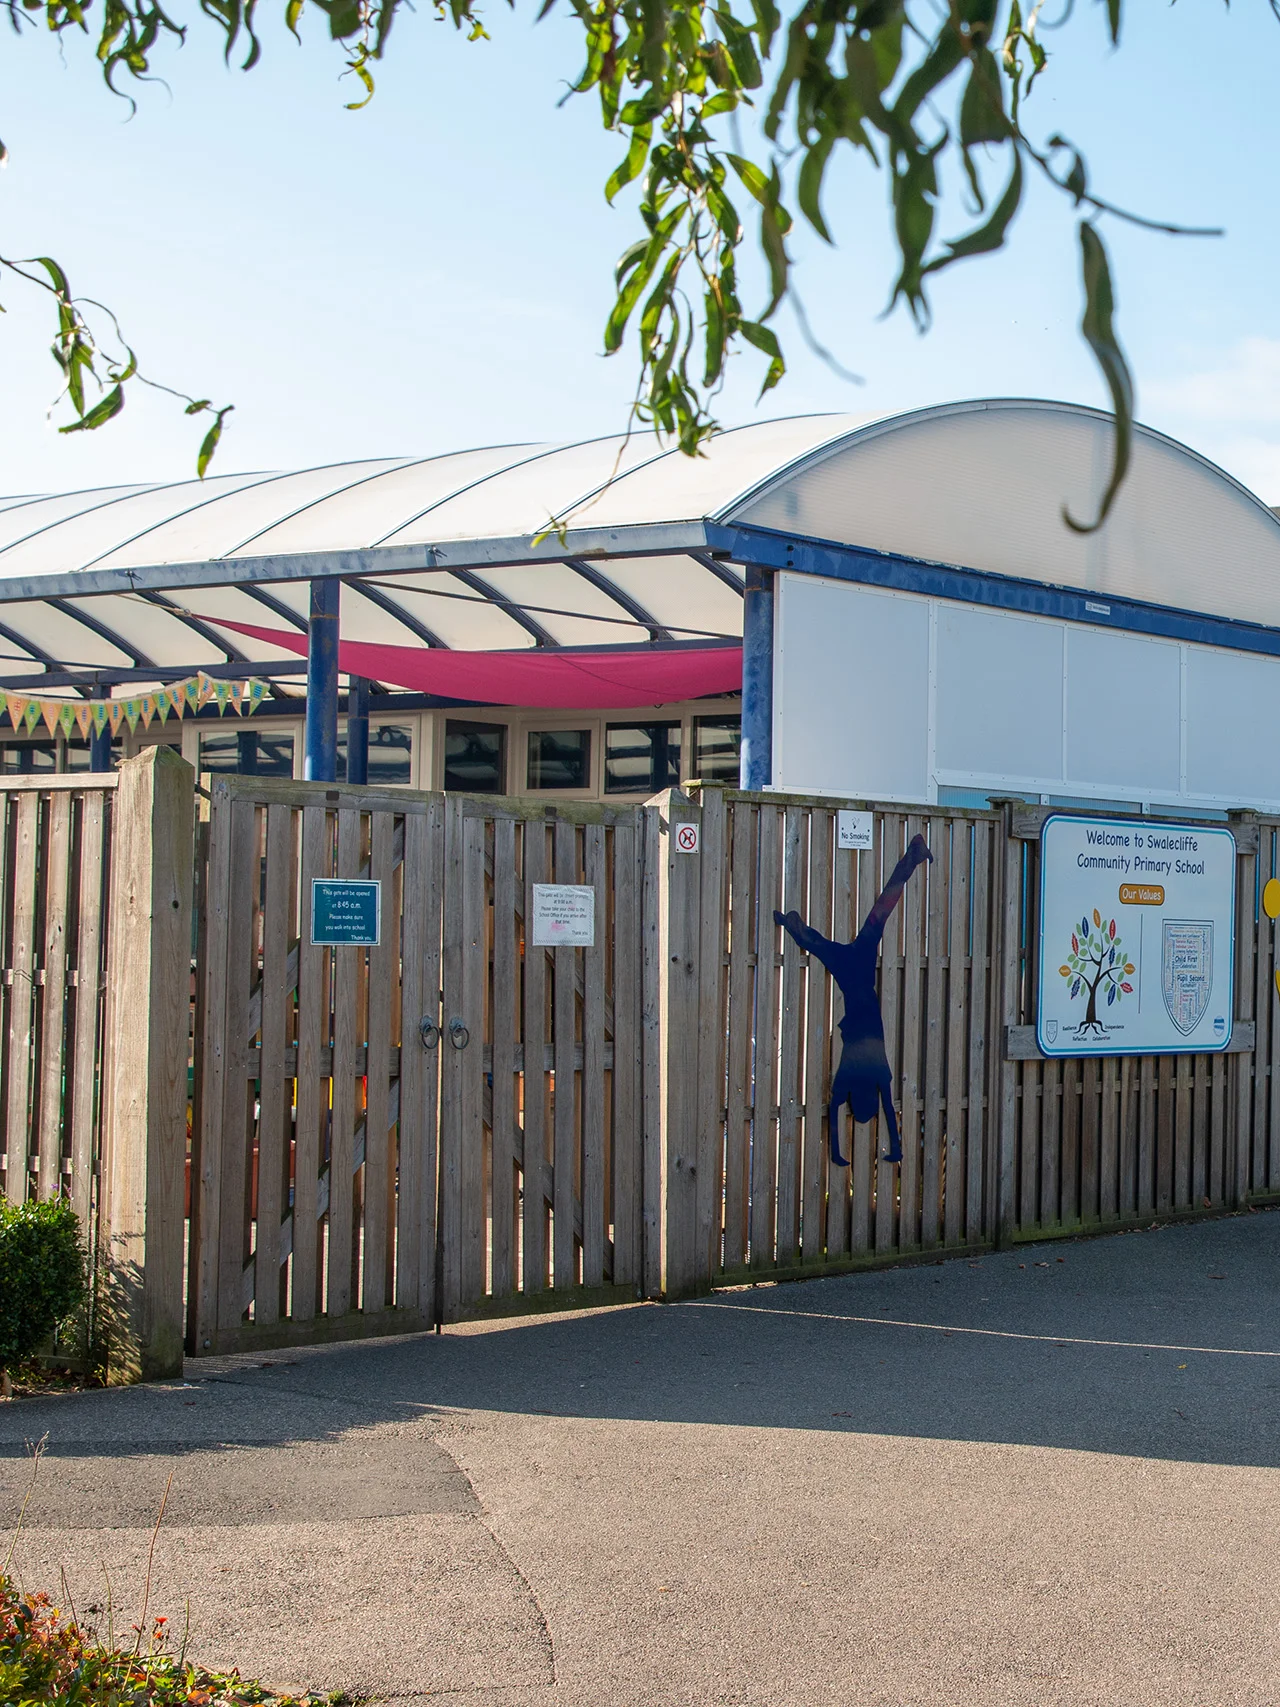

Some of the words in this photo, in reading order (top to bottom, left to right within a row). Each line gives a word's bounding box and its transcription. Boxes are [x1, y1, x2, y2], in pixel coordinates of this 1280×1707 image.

[850, 832, 870, 842] Smoking
[1086, 829, 1130, 847] Welcome
[1134, 832, 1144, 848] to
[1147, 834, 1198, 852] Swalecliffe
[1077, 853, 1130, 874] Community
[1134, 856, 1172, 876] Primary
[1175, 860, 1205, 875] School
[1122, 888, 1137, 900] Our
[1139, 888, 1161, 901] Values
